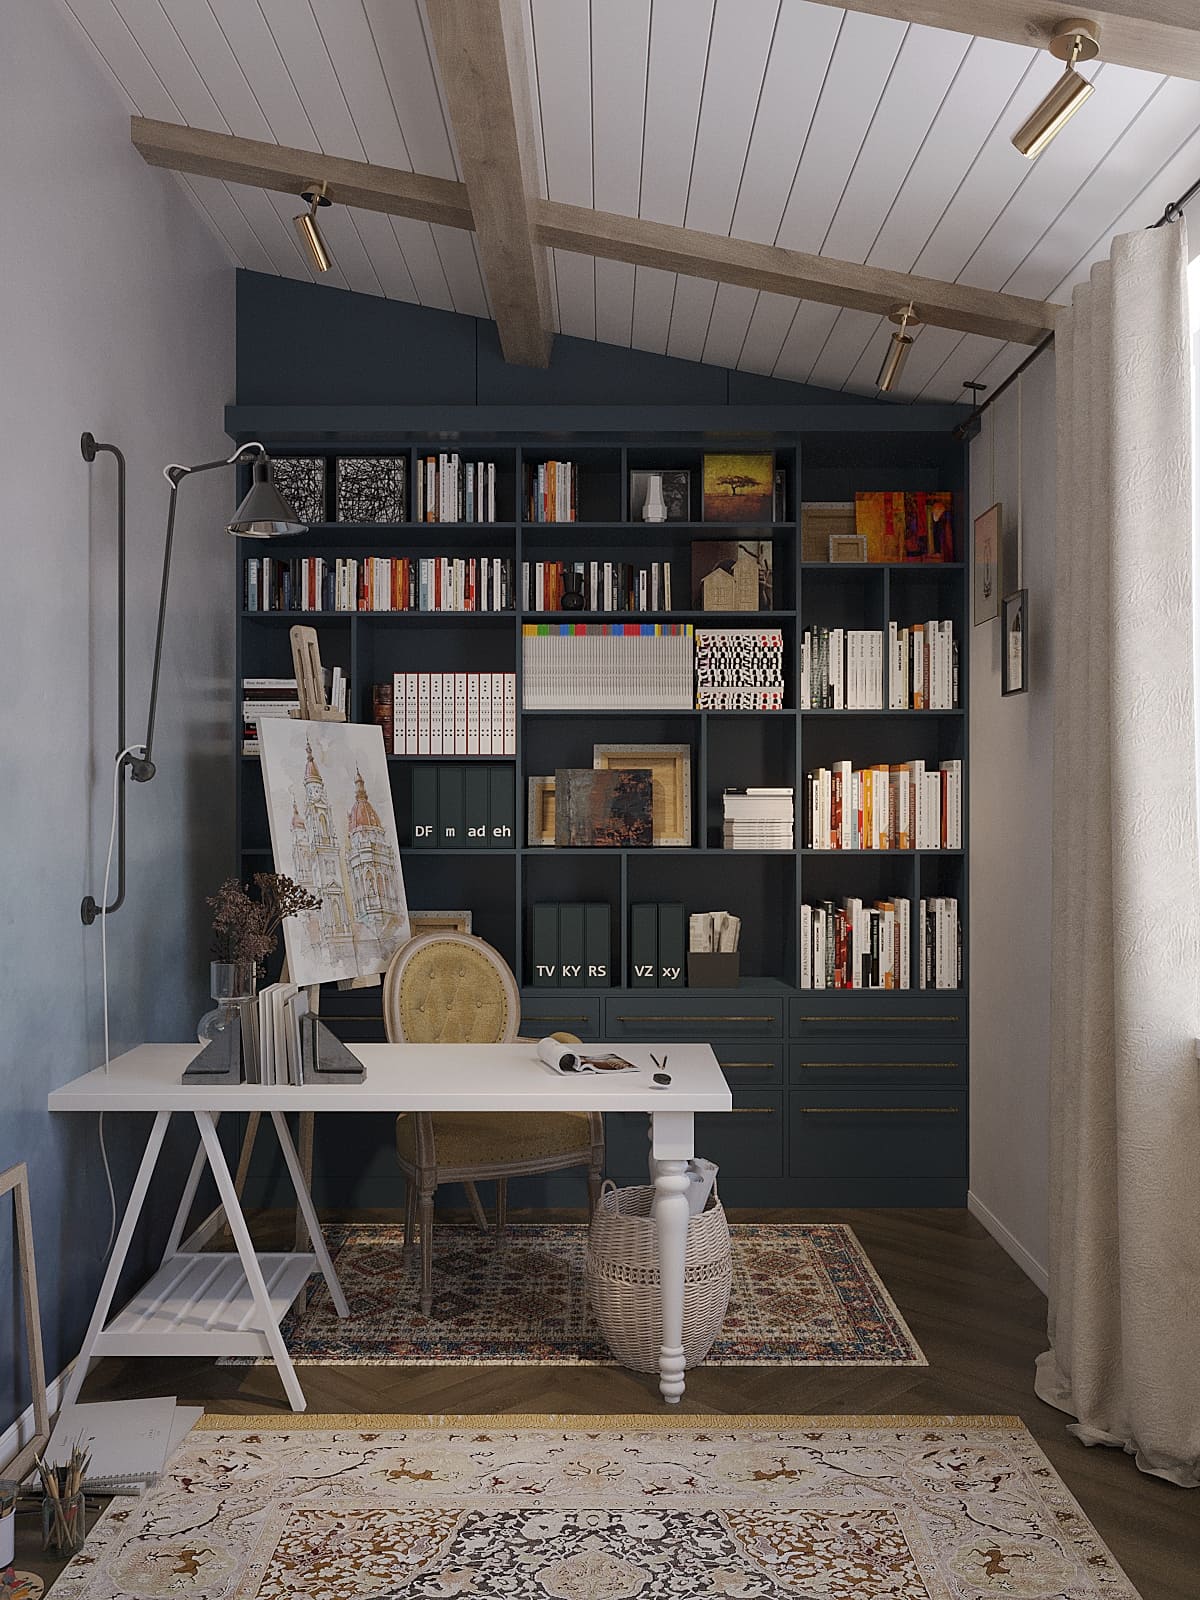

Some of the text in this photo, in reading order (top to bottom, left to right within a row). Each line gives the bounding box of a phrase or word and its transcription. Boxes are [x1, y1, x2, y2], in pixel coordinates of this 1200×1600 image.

[415, 825, 433, 838] DF
[445, 827, 456, 838] m
[467, 824, 486, 838] ad
[492, 824, 511, 838] eh
[536, 965, 556, 977] TV
[562, 965, 582, 977] KY
[588, 965, 607, 977] RS
[634, 965, 654, 977] VZ
[662, 967, 681, 980] xy
